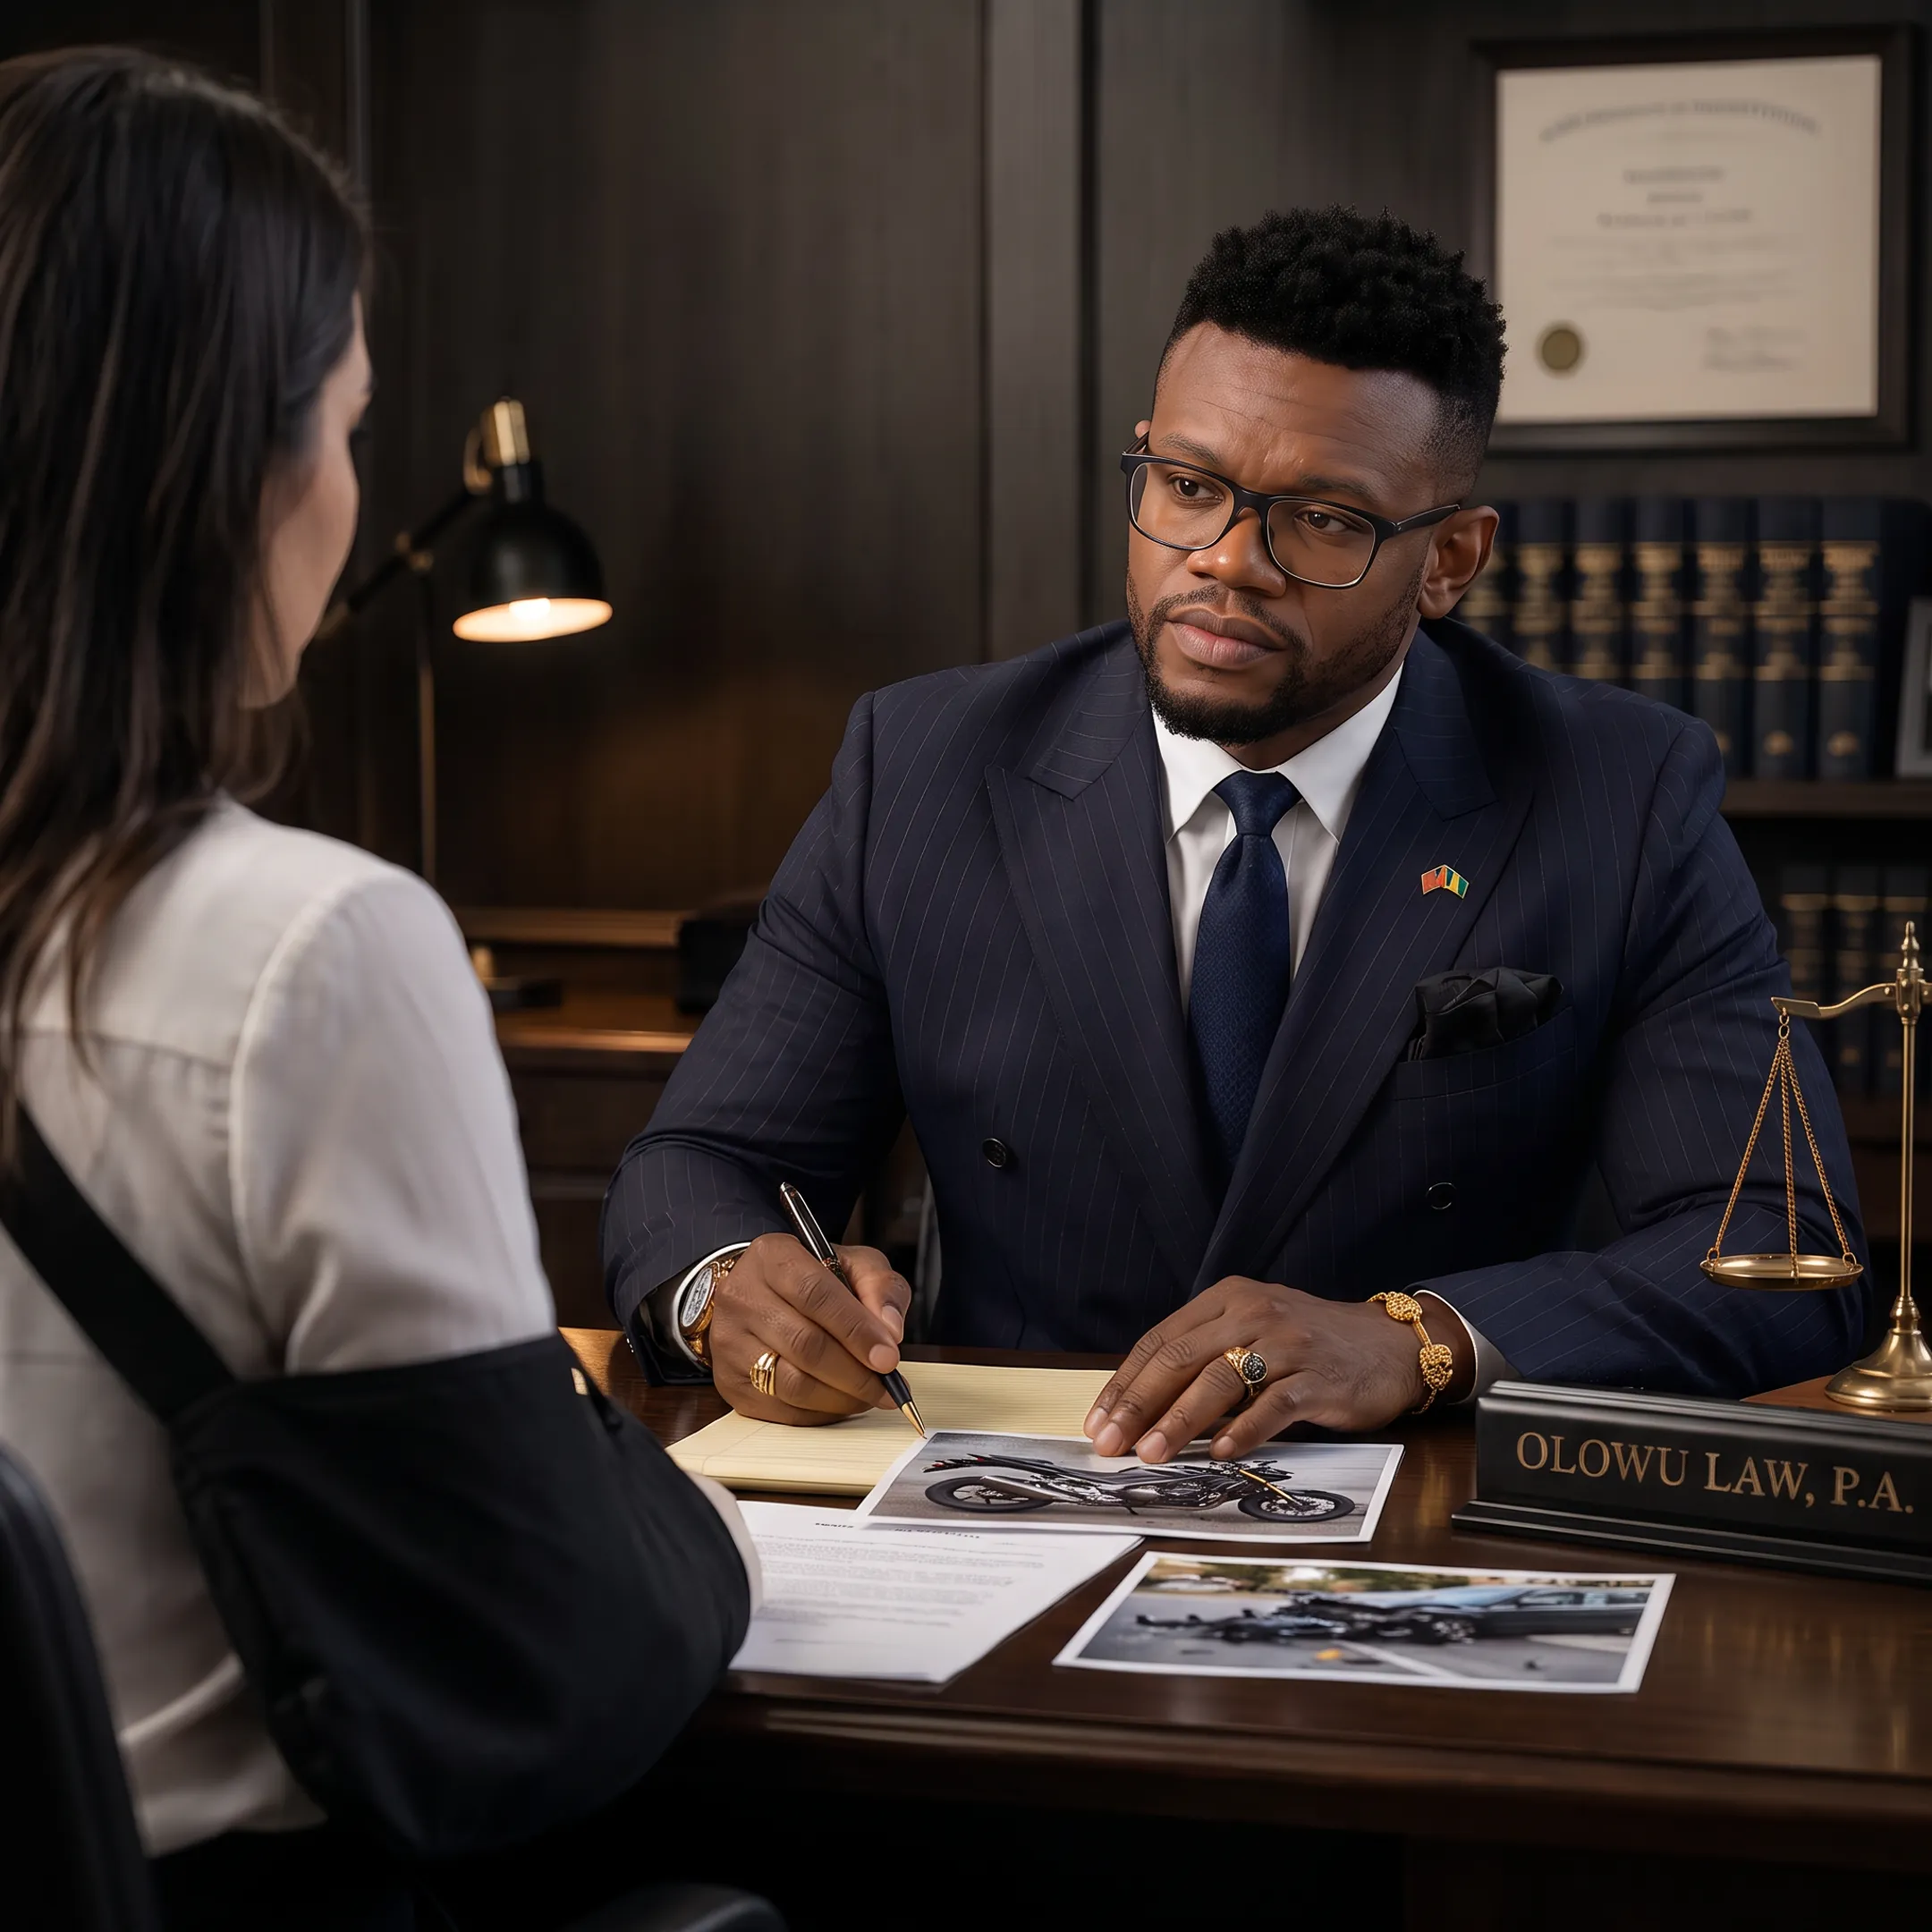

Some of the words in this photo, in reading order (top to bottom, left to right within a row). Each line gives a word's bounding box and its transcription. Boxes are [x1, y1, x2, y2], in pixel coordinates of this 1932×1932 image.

[1516, 1431, 1689, 1487] OLOWU
[1704, 1452, 1815, 1507] LAW,
[1830, 1466, 1915, 1515] P.A.
